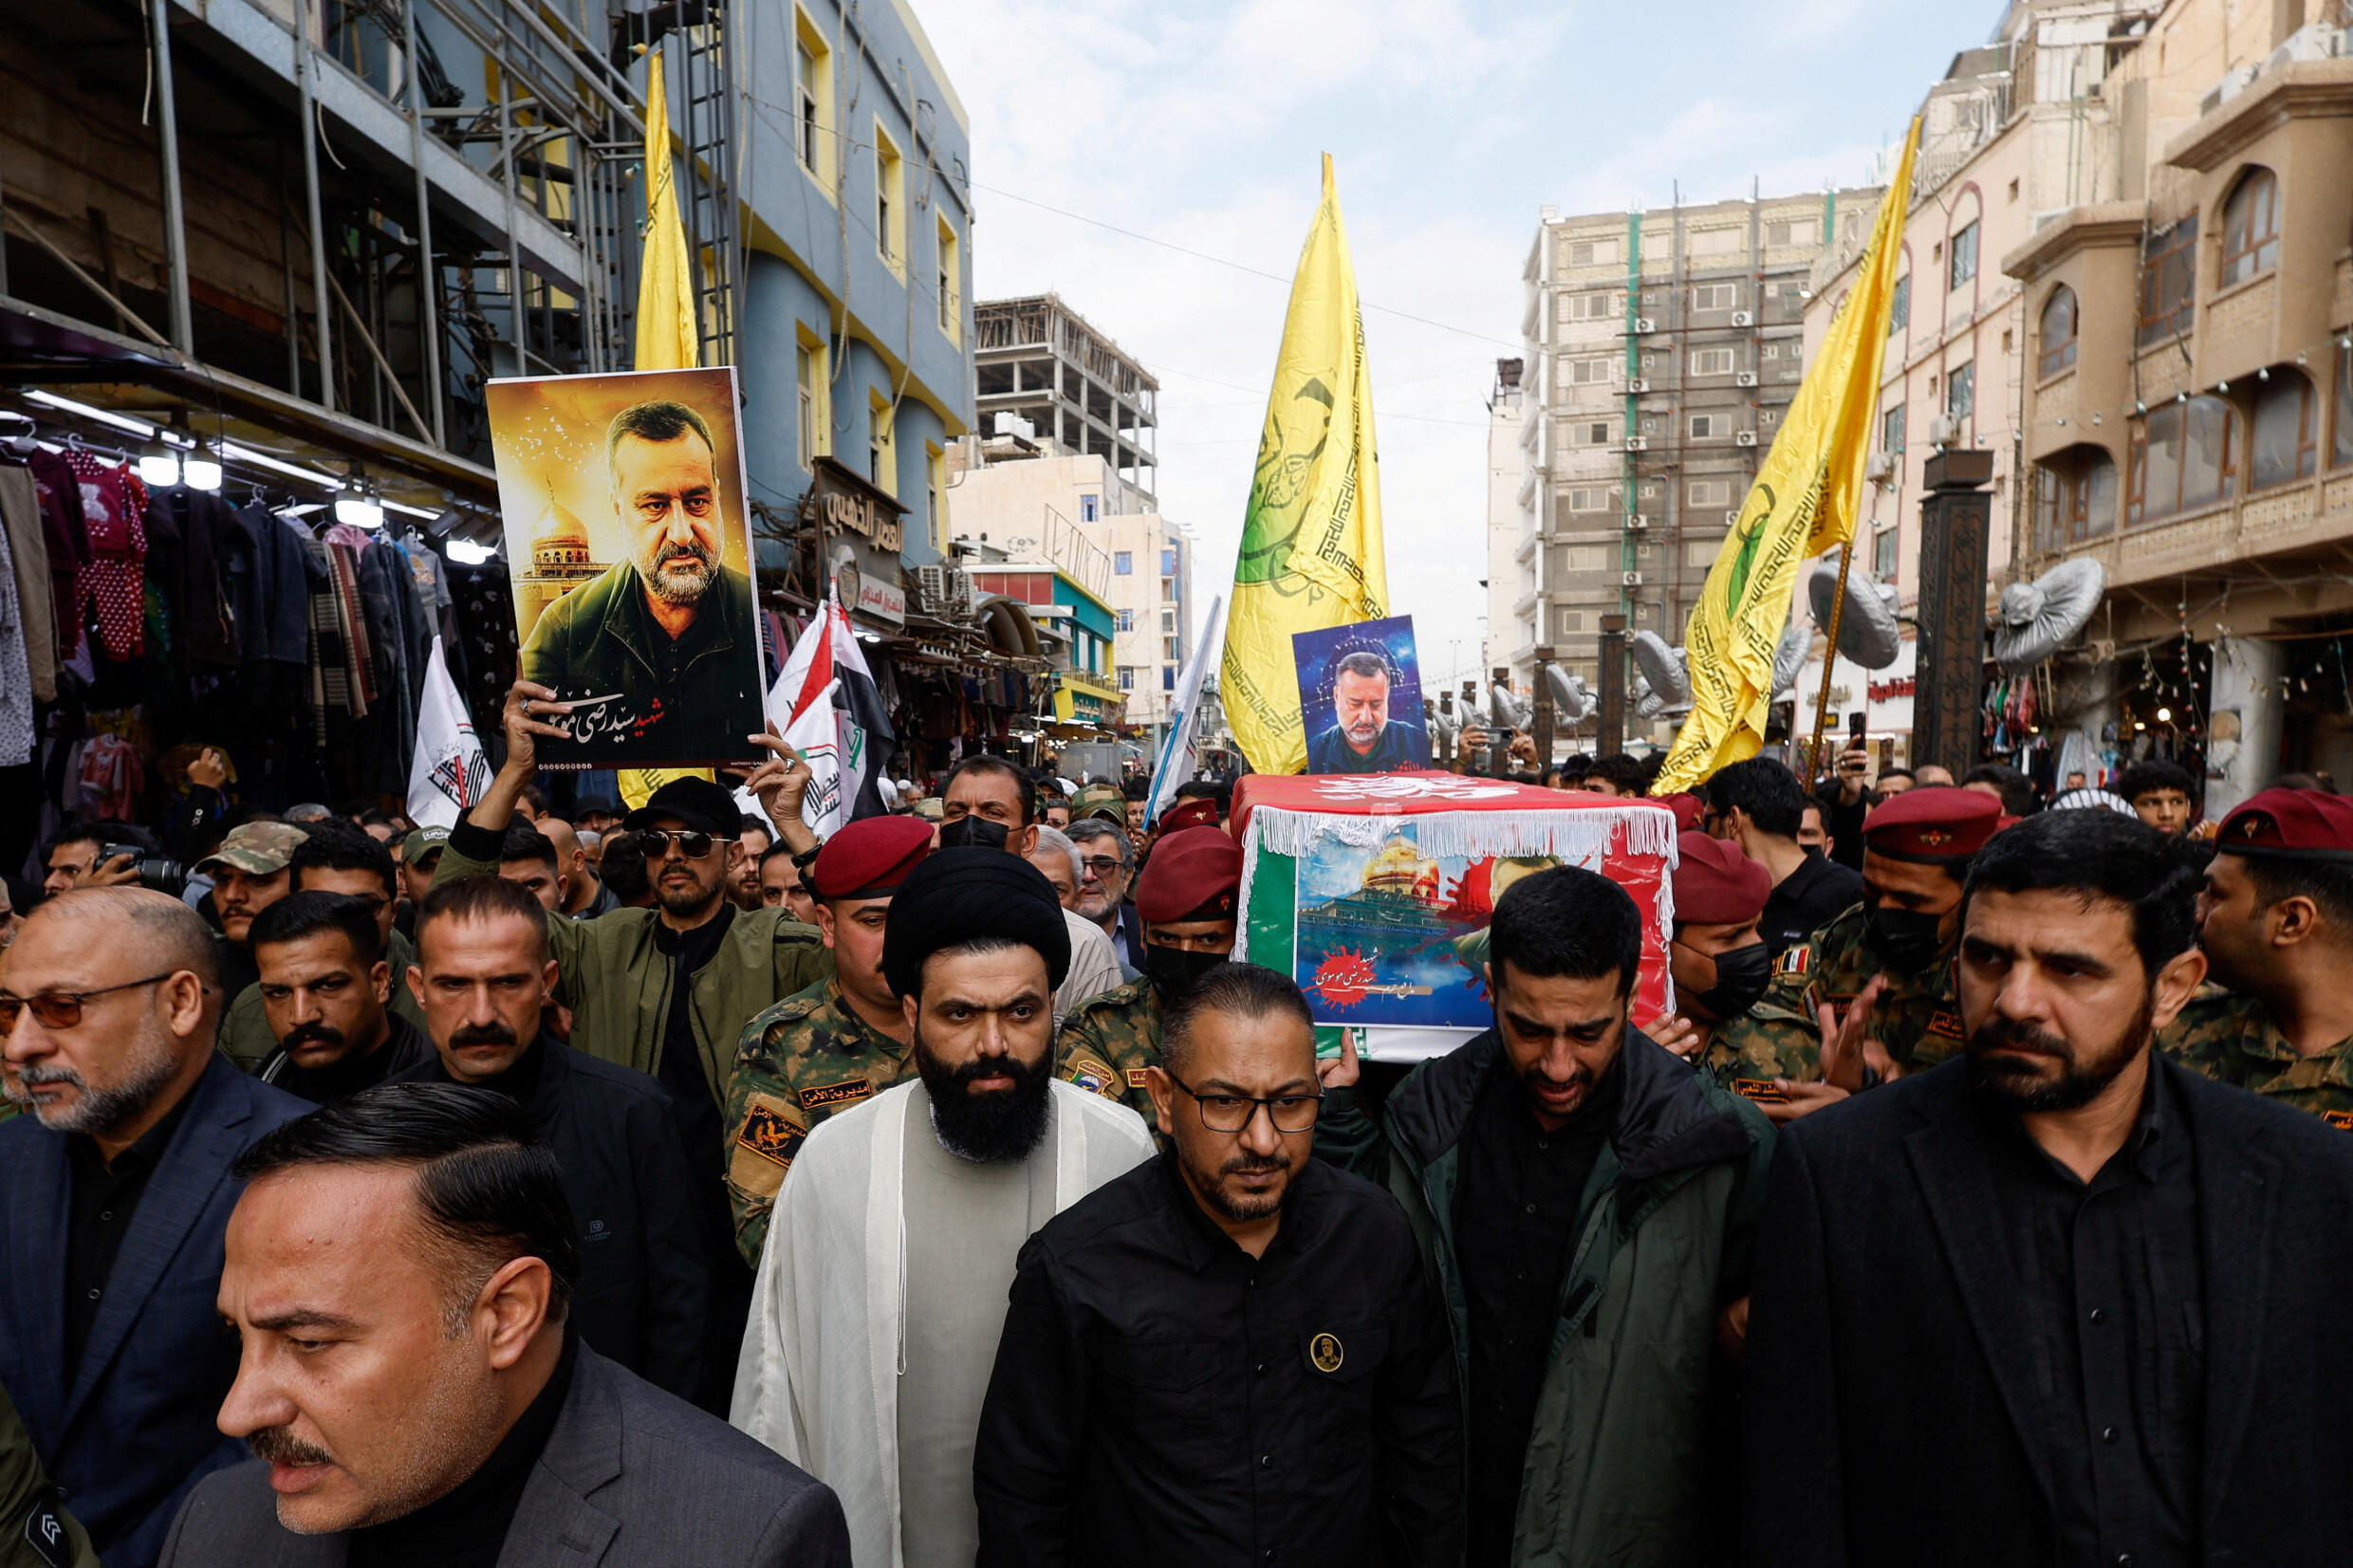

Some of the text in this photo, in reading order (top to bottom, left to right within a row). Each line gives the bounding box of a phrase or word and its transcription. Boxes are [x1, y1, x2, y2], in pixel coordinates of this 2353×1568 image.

[825, 492, 874, 537] الذهبي
[805, 1085, 869, 1106] مديرية الأمن
